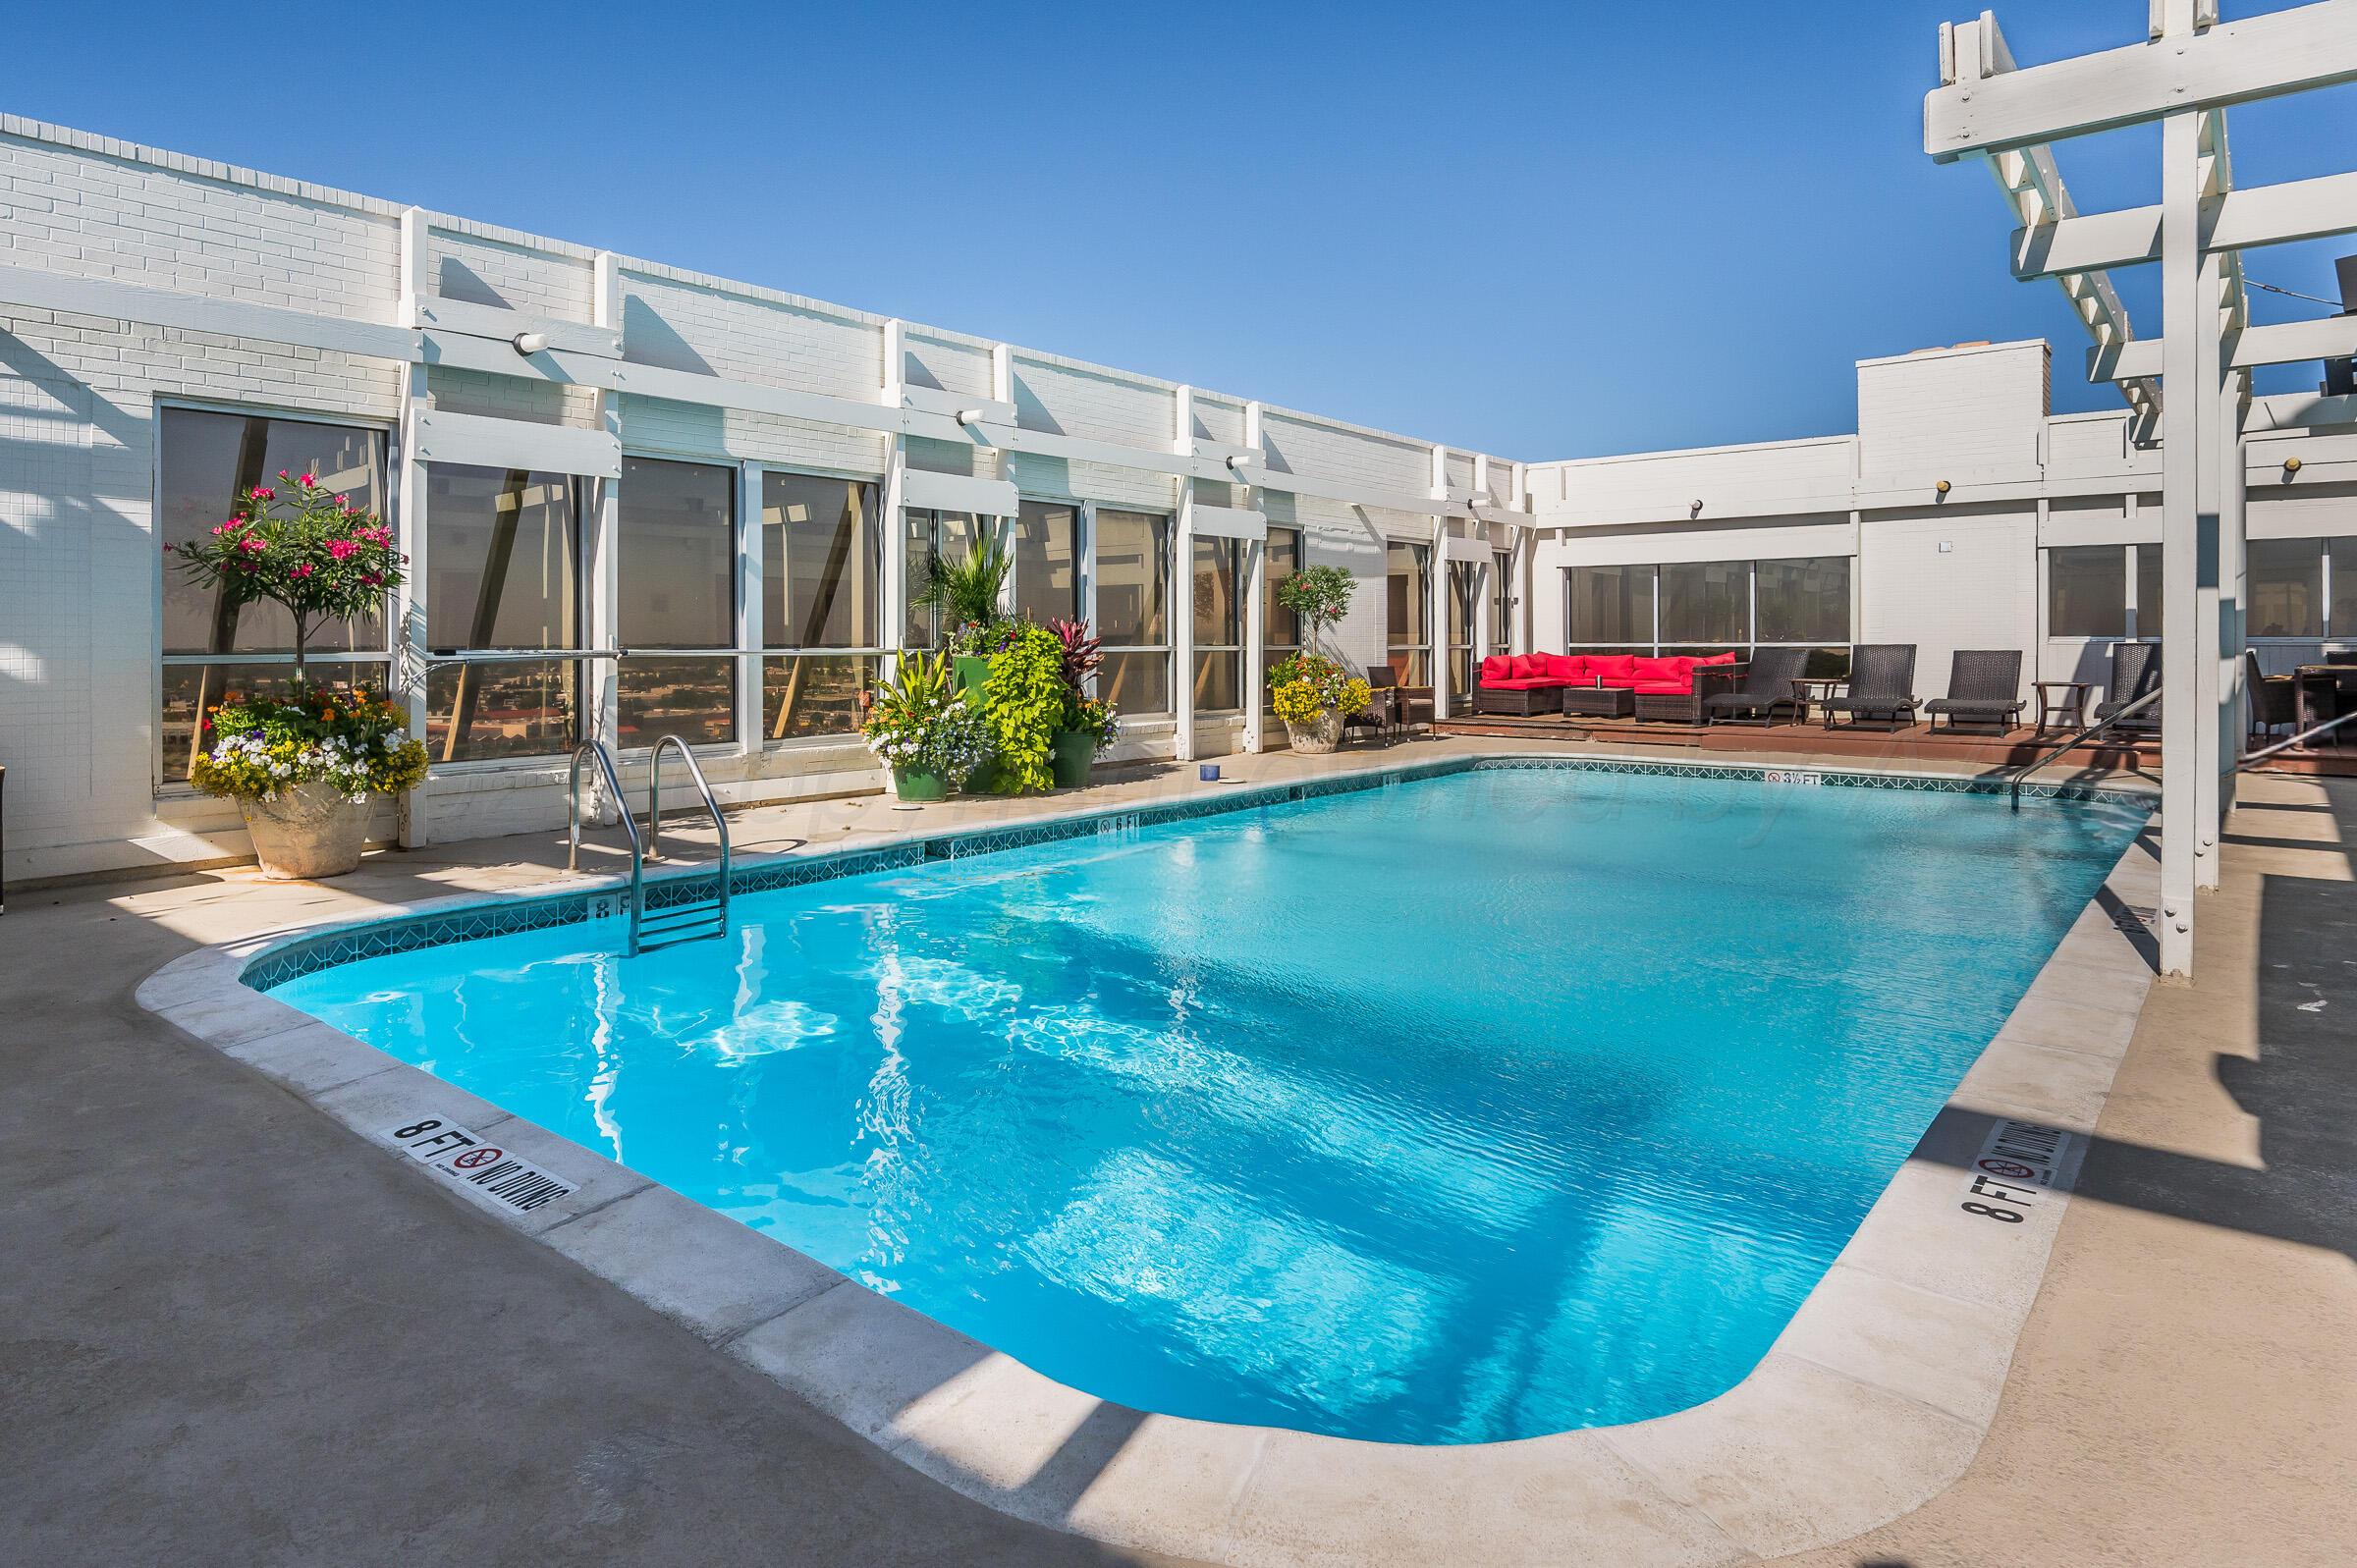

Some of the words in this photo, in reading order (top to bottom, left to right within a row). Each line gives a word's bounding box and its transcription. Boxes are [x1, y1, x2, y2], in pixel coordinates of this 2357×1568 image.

[1803, 774, 1819, 784] FT
[1116, 816, 1122, 831] 6
[595, 899, 609, 918] 8
[394, 1119, 442, 1139] 8
[411, 1130, 476, 1159] FT
[1991, 1146, 2051, 1165] NO
[466, 1160, 522, 1186] NO
[487, 1170, 570, 1212] DIVING
[1970, 1175, 2037, 1207] FT
[1961, 1202, 2023, 1222] 8
